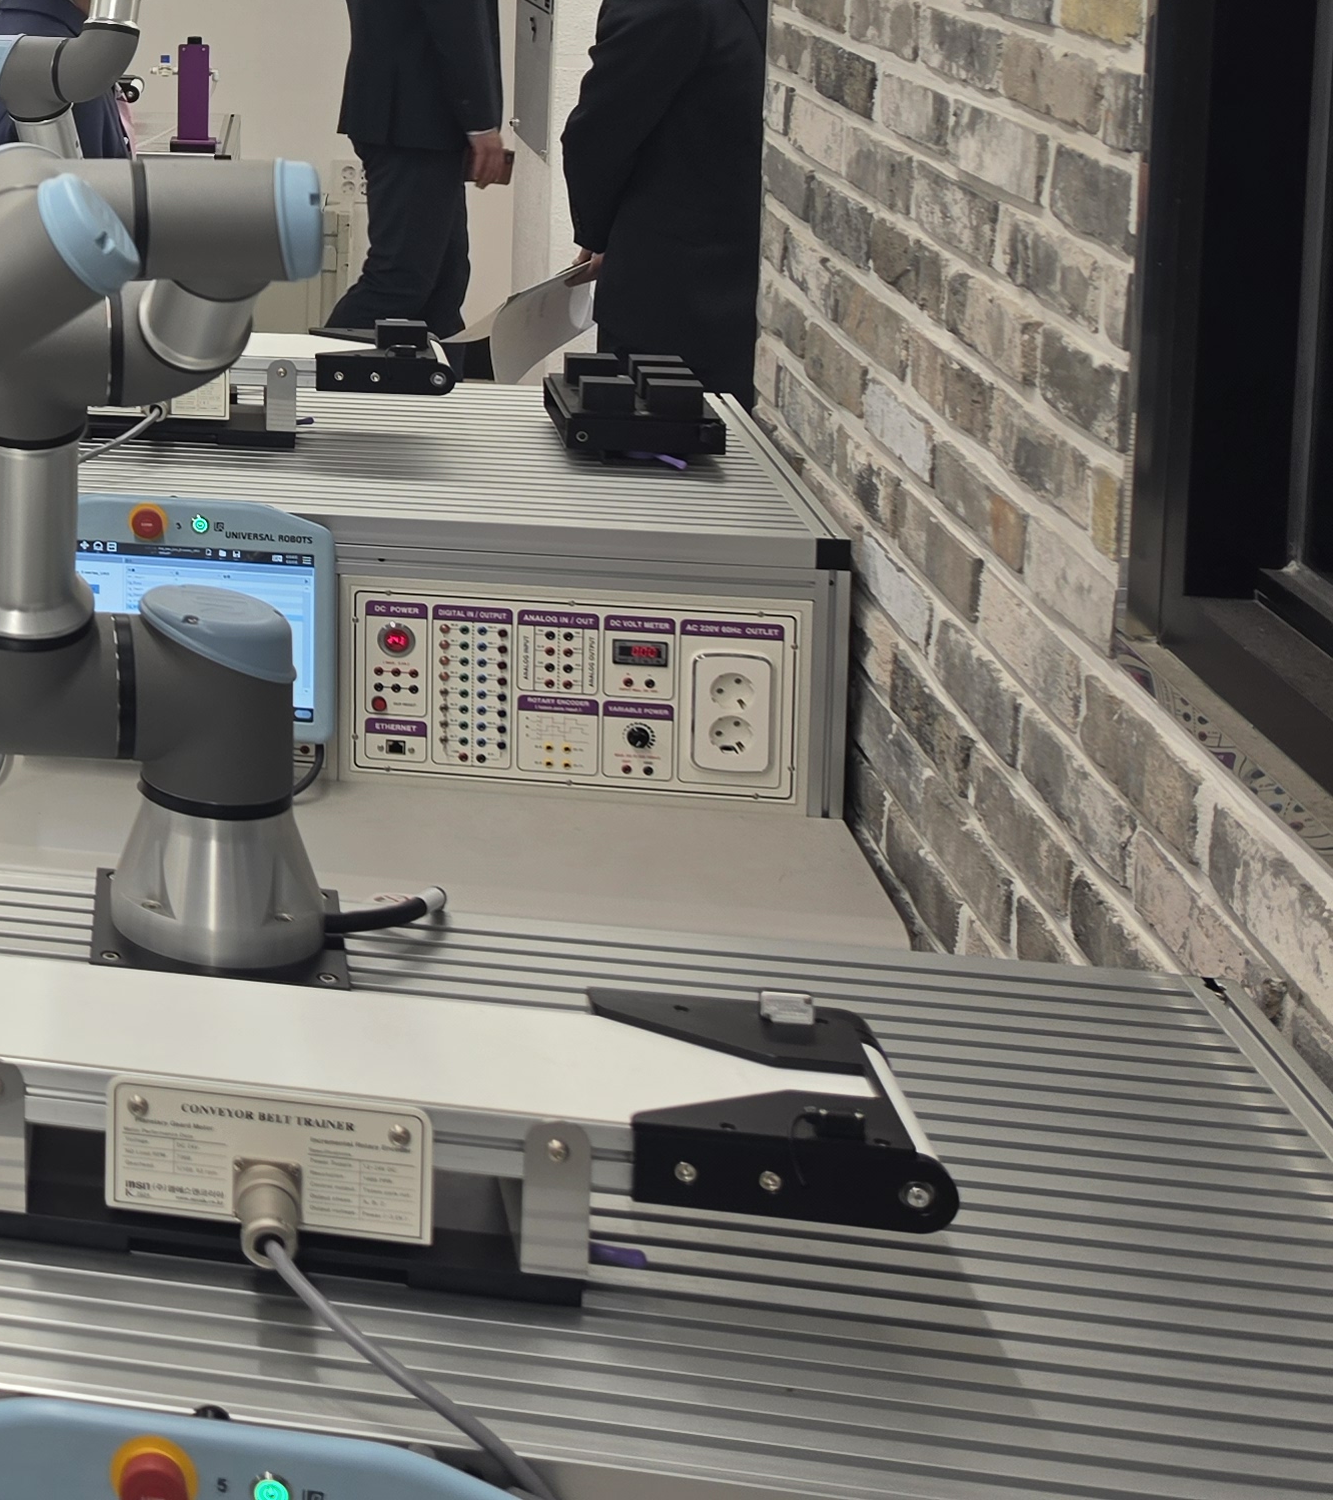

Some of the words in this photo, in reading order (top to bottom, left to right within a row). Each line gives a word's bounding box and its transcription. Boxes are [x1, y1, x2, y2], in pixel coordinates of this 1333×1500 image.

[225, 530, 275, 543] UNIVERSAL
[278, 533, 313, 545] ROBOTS
[390, 606, 419, 614] POWER
[375, 723, 417, 732] ETHERNET
[181, 1103, 254, 1123] CONVEYOR
[257, 1110, 292, 1125] BELT
[296, 1115, 355, 1132] TRAINER
[217, 1478, 228, 1493] 5
